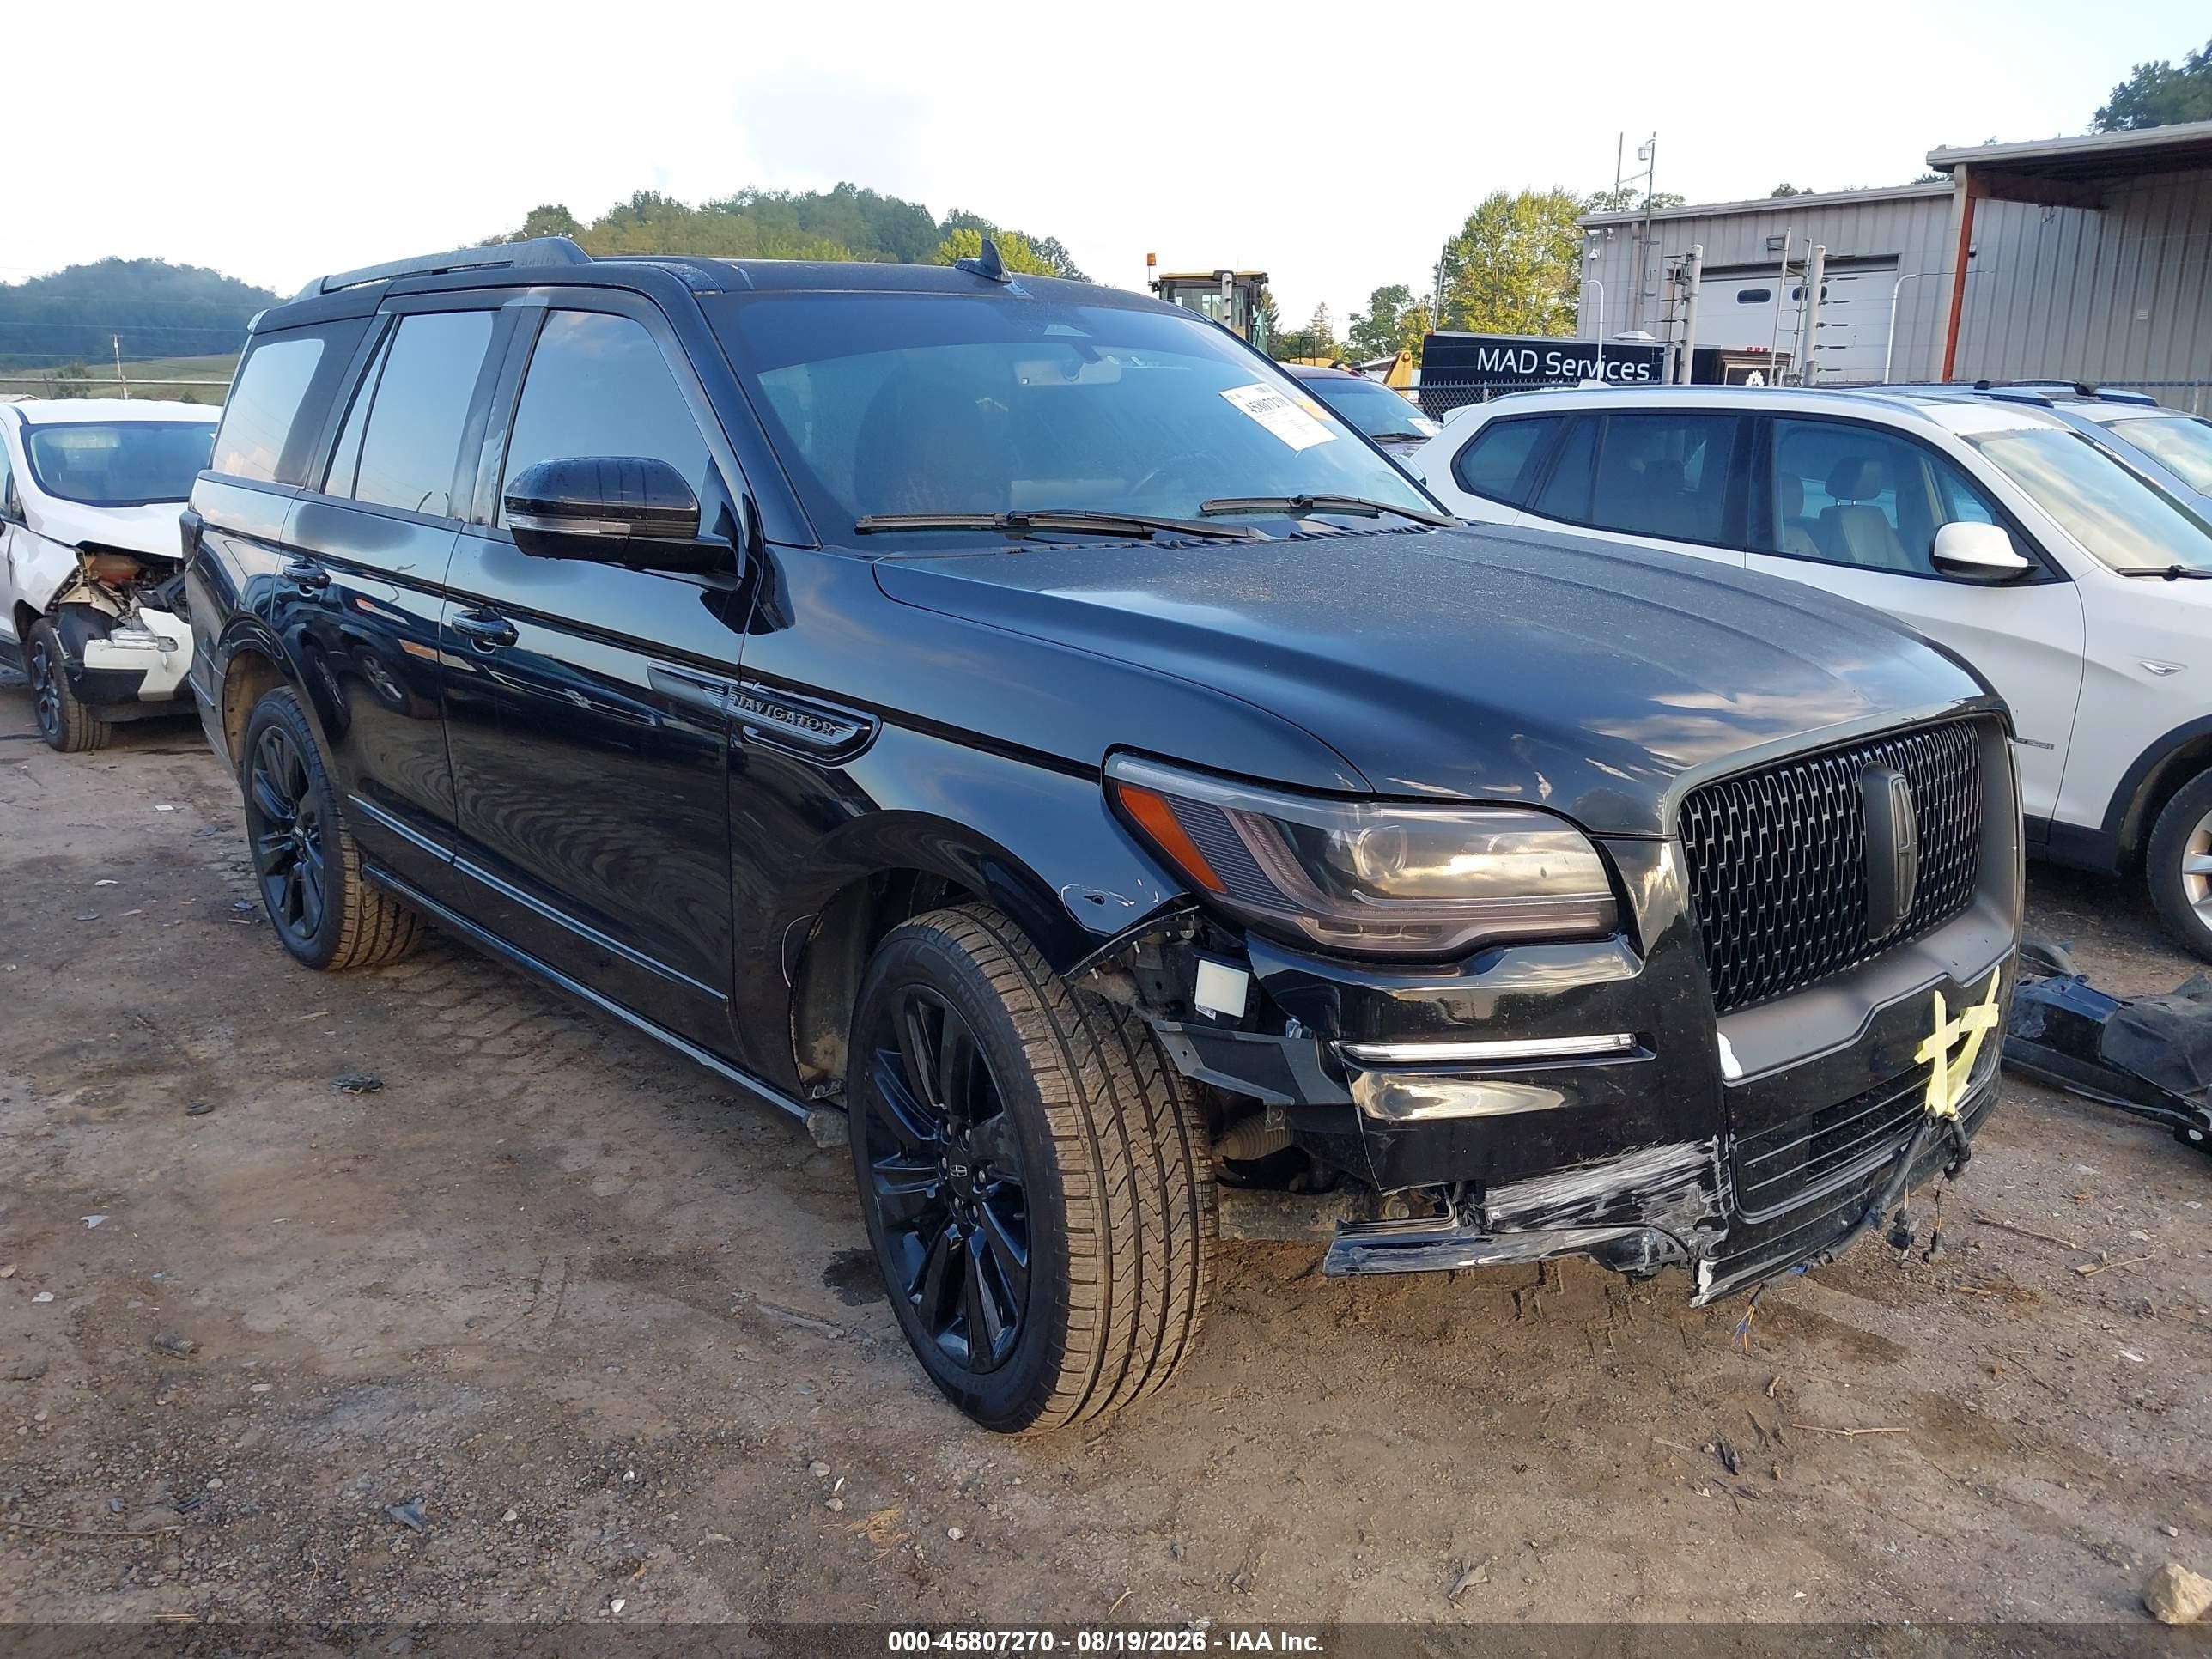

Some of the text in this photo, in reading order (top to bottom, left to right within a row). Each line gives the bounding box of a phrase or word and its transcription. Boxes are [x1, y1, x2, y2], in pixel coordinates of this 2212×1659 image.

[1477, 347, 1650, 381] MAD Services
[732, 694, 838, 738] NAVIGATOR
